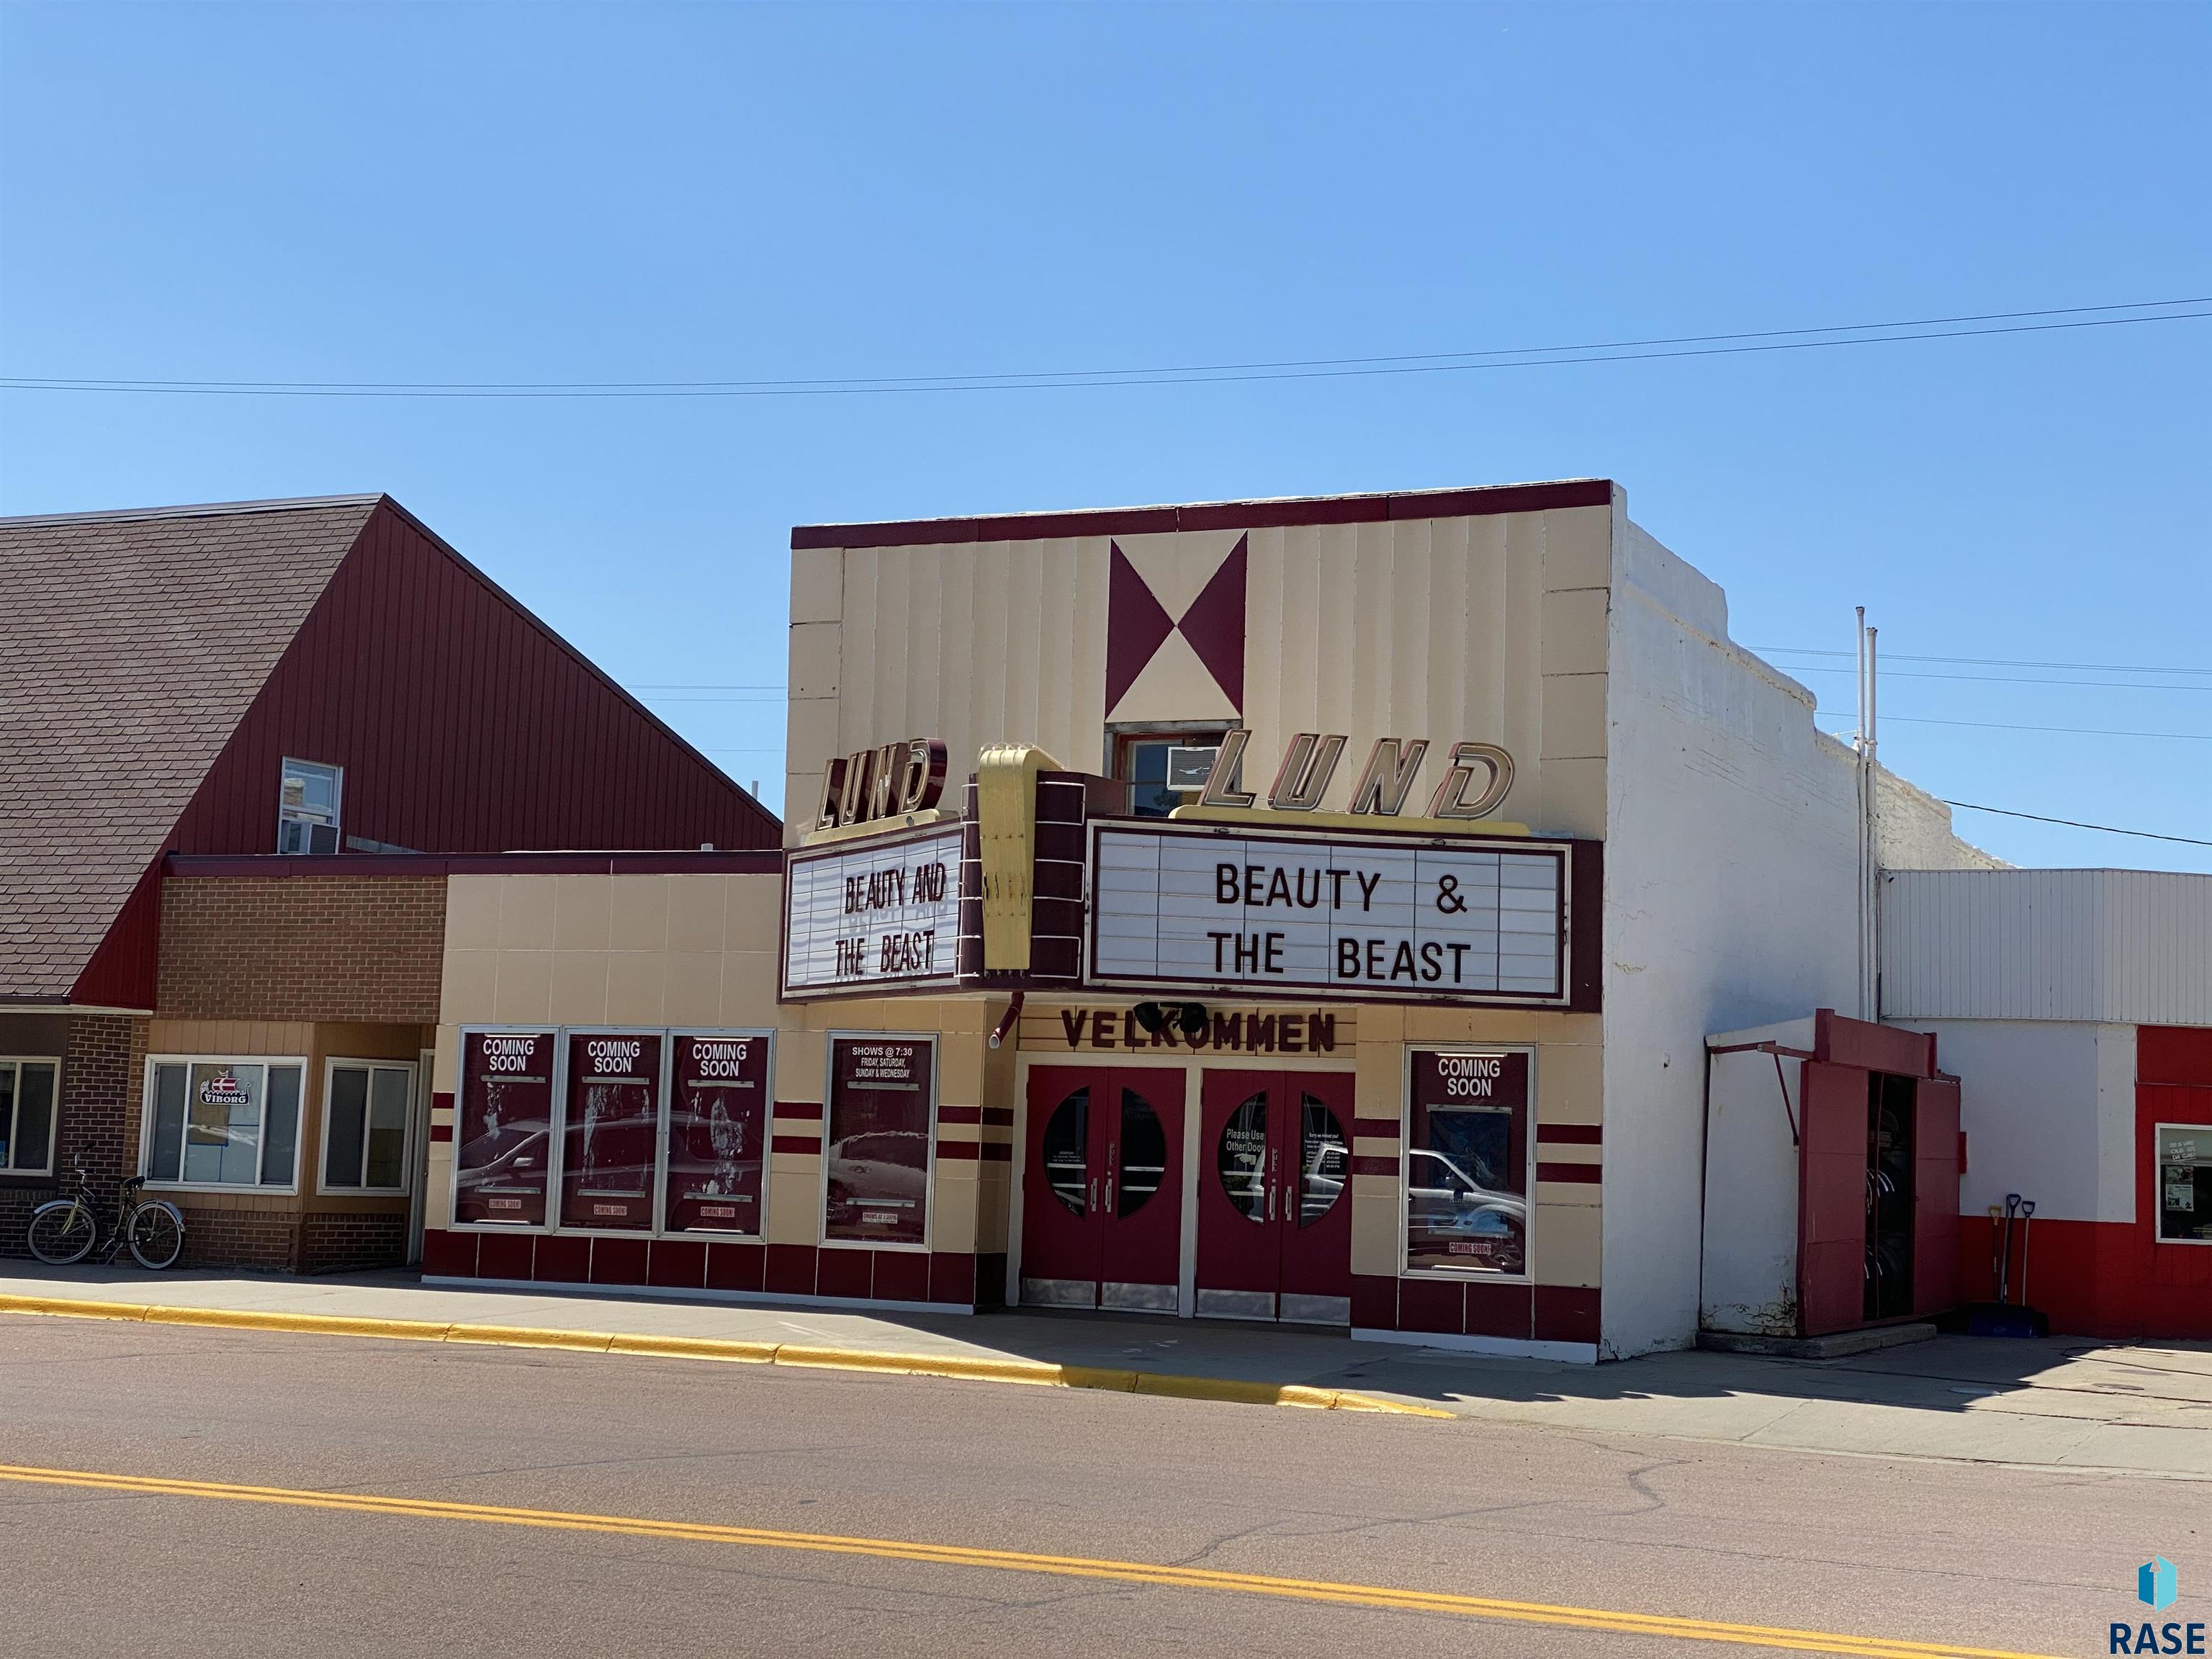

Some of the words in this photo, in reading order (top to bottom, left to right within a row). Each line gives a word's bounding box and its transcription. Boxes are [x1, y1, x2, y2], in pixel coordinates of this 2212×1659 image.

[1197, 729, 1515, 821] LUND
[815, 737, 948, 832] LUND
[845, 867, 906, 914] BEAUTY
[912, 863, 946, 905] AND
[1216, 863, 1381, 912] BEAUTY
[1436, 874, 1468, 914] &
[835, 938, 865, 976] THE
[880, 930, 935, 973] BEAST
[1207, 932, 1285, 974] THE
[1337, 938, 1472, 984] BEAST
[1061, 1010, 1334, 1052] VELKOMMEN
[483, 1039, 534, 1055] COMING
[588, 1041, 641, 1058] COMING
[692, 1043, 747, 1061] COMING
[852, 1047, 884, 1056] SHOWS
[885, 1047, 894, 1058] @
[896, 1048, 913, 1056] 7:30
[489, 1056, 526, 1071] SOON
[594, 1057, 632, 1073] SOON
[700, 1060, 739, 1076] SOON
[860, 1058, 879, 1069] FRIDAY,
[879, 1058, 906, 1069] SATURDAY,
[1438, 1058, 1501, 1078] COMING
[855, 1068, 875, 1077] SUNDAY
[876, 1069, 879, 1077] &
[880, 1069, 910, 1078] WEDNESDAY
[1447, 1078, 1492, 1096] SOON
[204, 1093, 247, 1103] VIBORG
[1226, 1128, 1250, 1139] Please
[1251, 1130, 1264, 1141] Use
[1226, 1141, 1246, 1152] Other
[1449, 1243, 1473, 1253] COMING
[1473, 1244, 1491, 1254] SOON!
